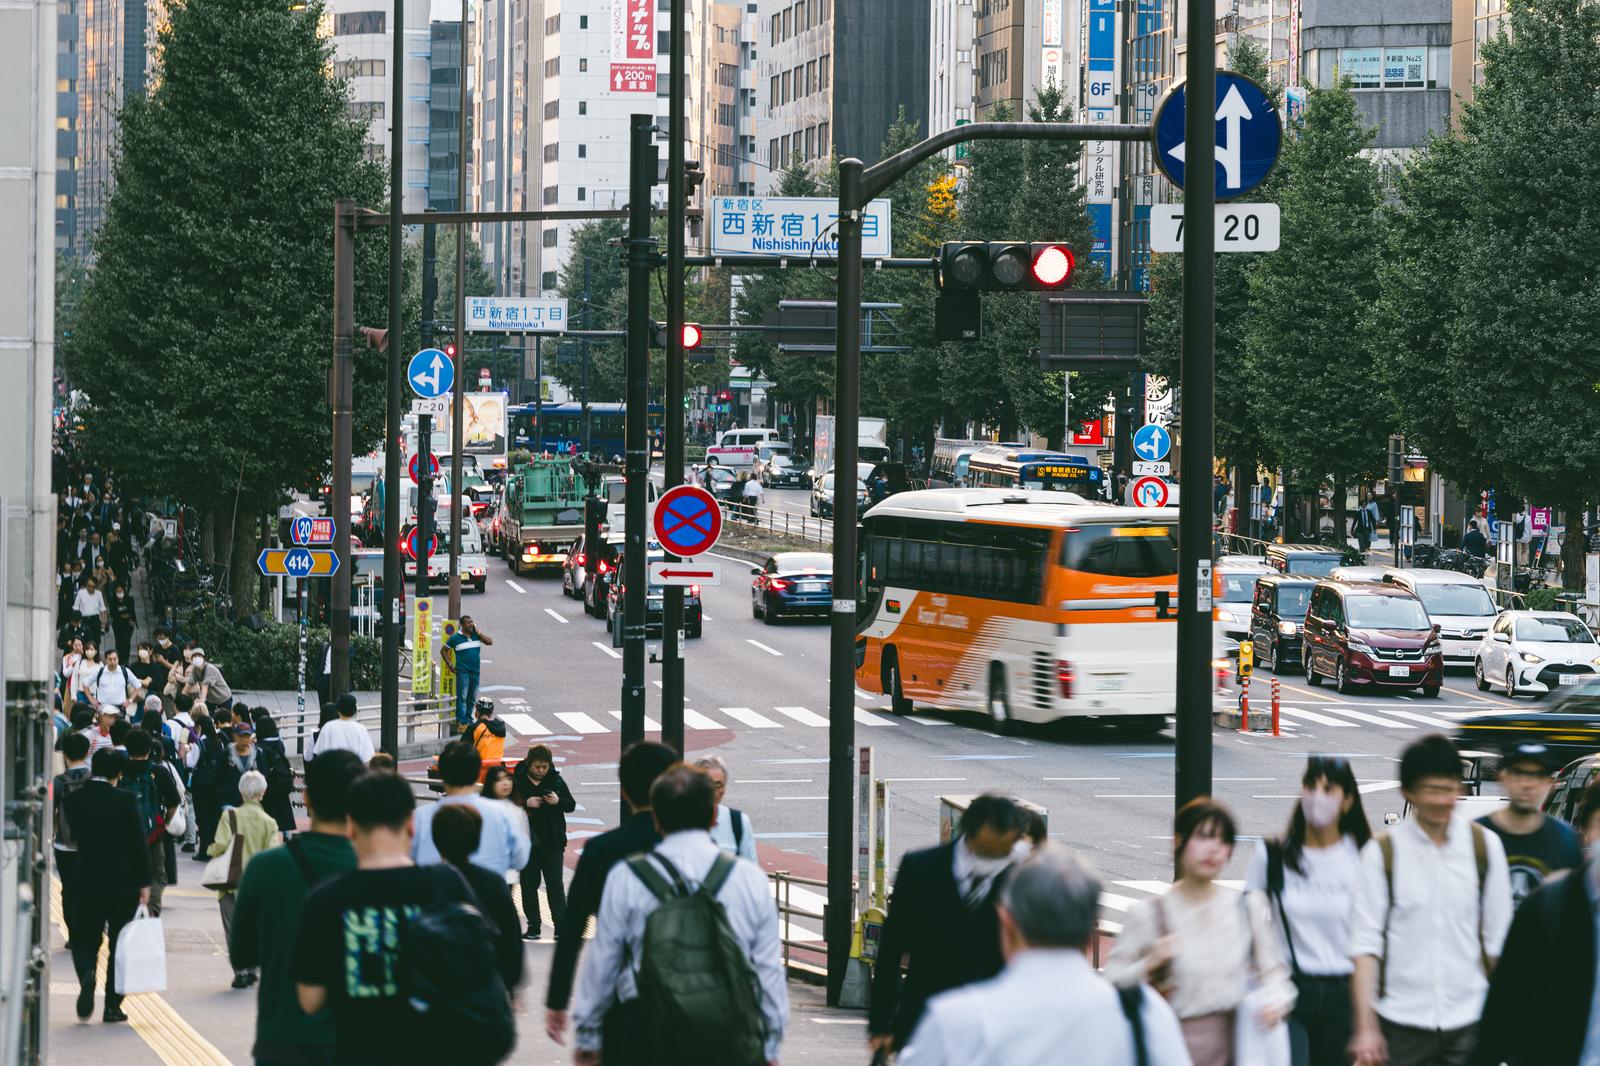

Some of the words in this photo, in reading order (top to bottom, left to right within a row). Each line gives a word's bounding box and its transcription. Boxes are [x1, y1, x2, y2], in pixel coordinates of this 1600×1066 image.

[624, 70, 652, 80] 200m
[1090, 82, 1111, 96] 6F
[722, 199, 764, 211] 新宿区
[472, 306, 562, 321] 西新宿1丁目
[488, 320, 539, 330] Nishishinjuku
[416, 402, 444, 412] 7-20
[1138, 464, 1165, 474] 7-20
[300, 520, 311, 538] 20
[288, 555, 310, 571] 414
